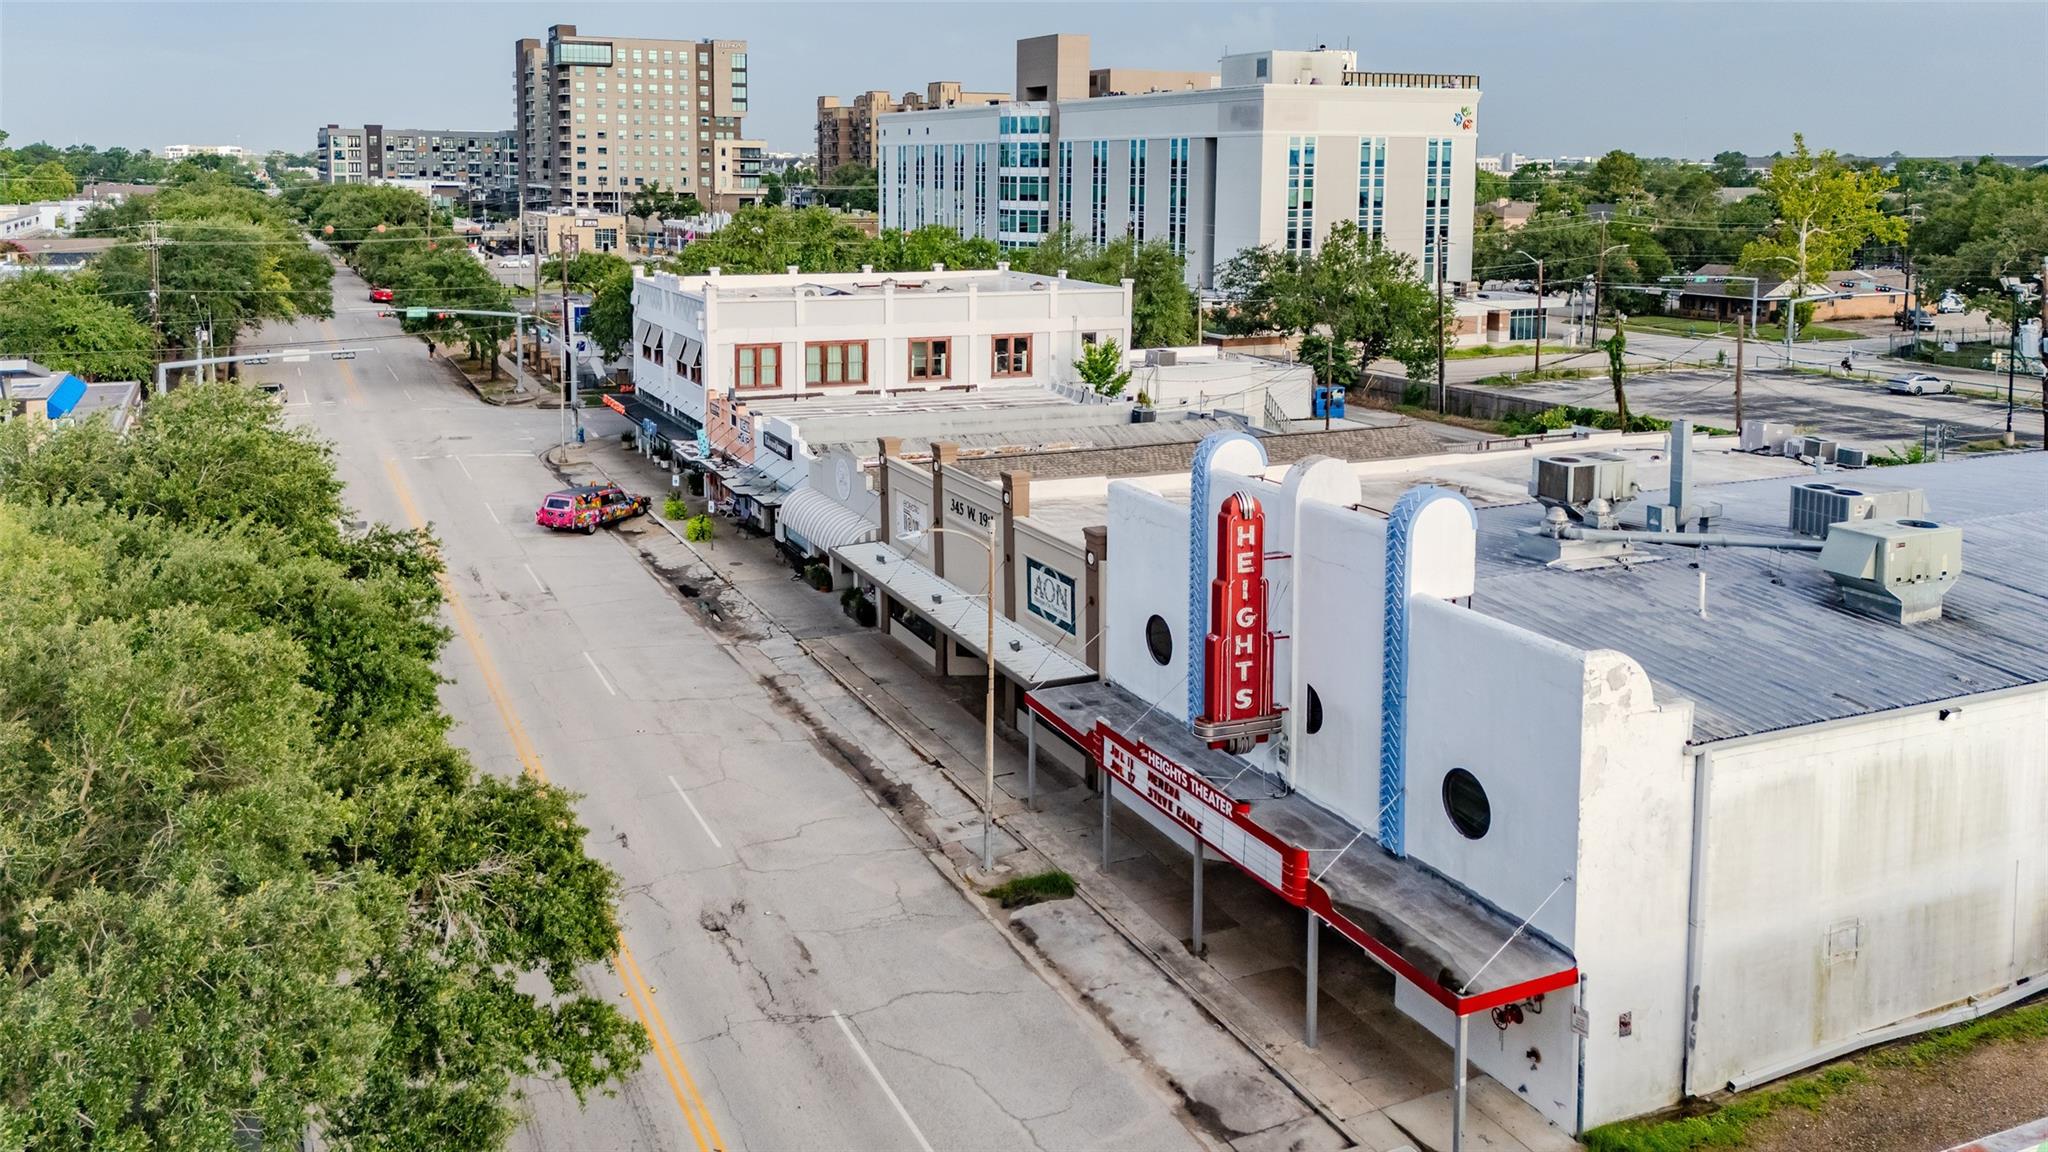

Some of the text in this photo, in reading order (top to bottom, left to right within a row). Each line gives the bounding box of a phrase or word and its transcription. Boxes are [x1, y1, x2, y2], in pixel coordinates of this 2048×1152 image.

[950, 498, 964, 516] 345
[1034, 575, 1068, 612] AON
[1234, 525, 1257, 710] HEIGHTS
[1147, 750, 1188, 788] HEIGHTS
[1190, 777, 1234, 819] THEATER
[1147, 786, 1173, 813] STEVE
